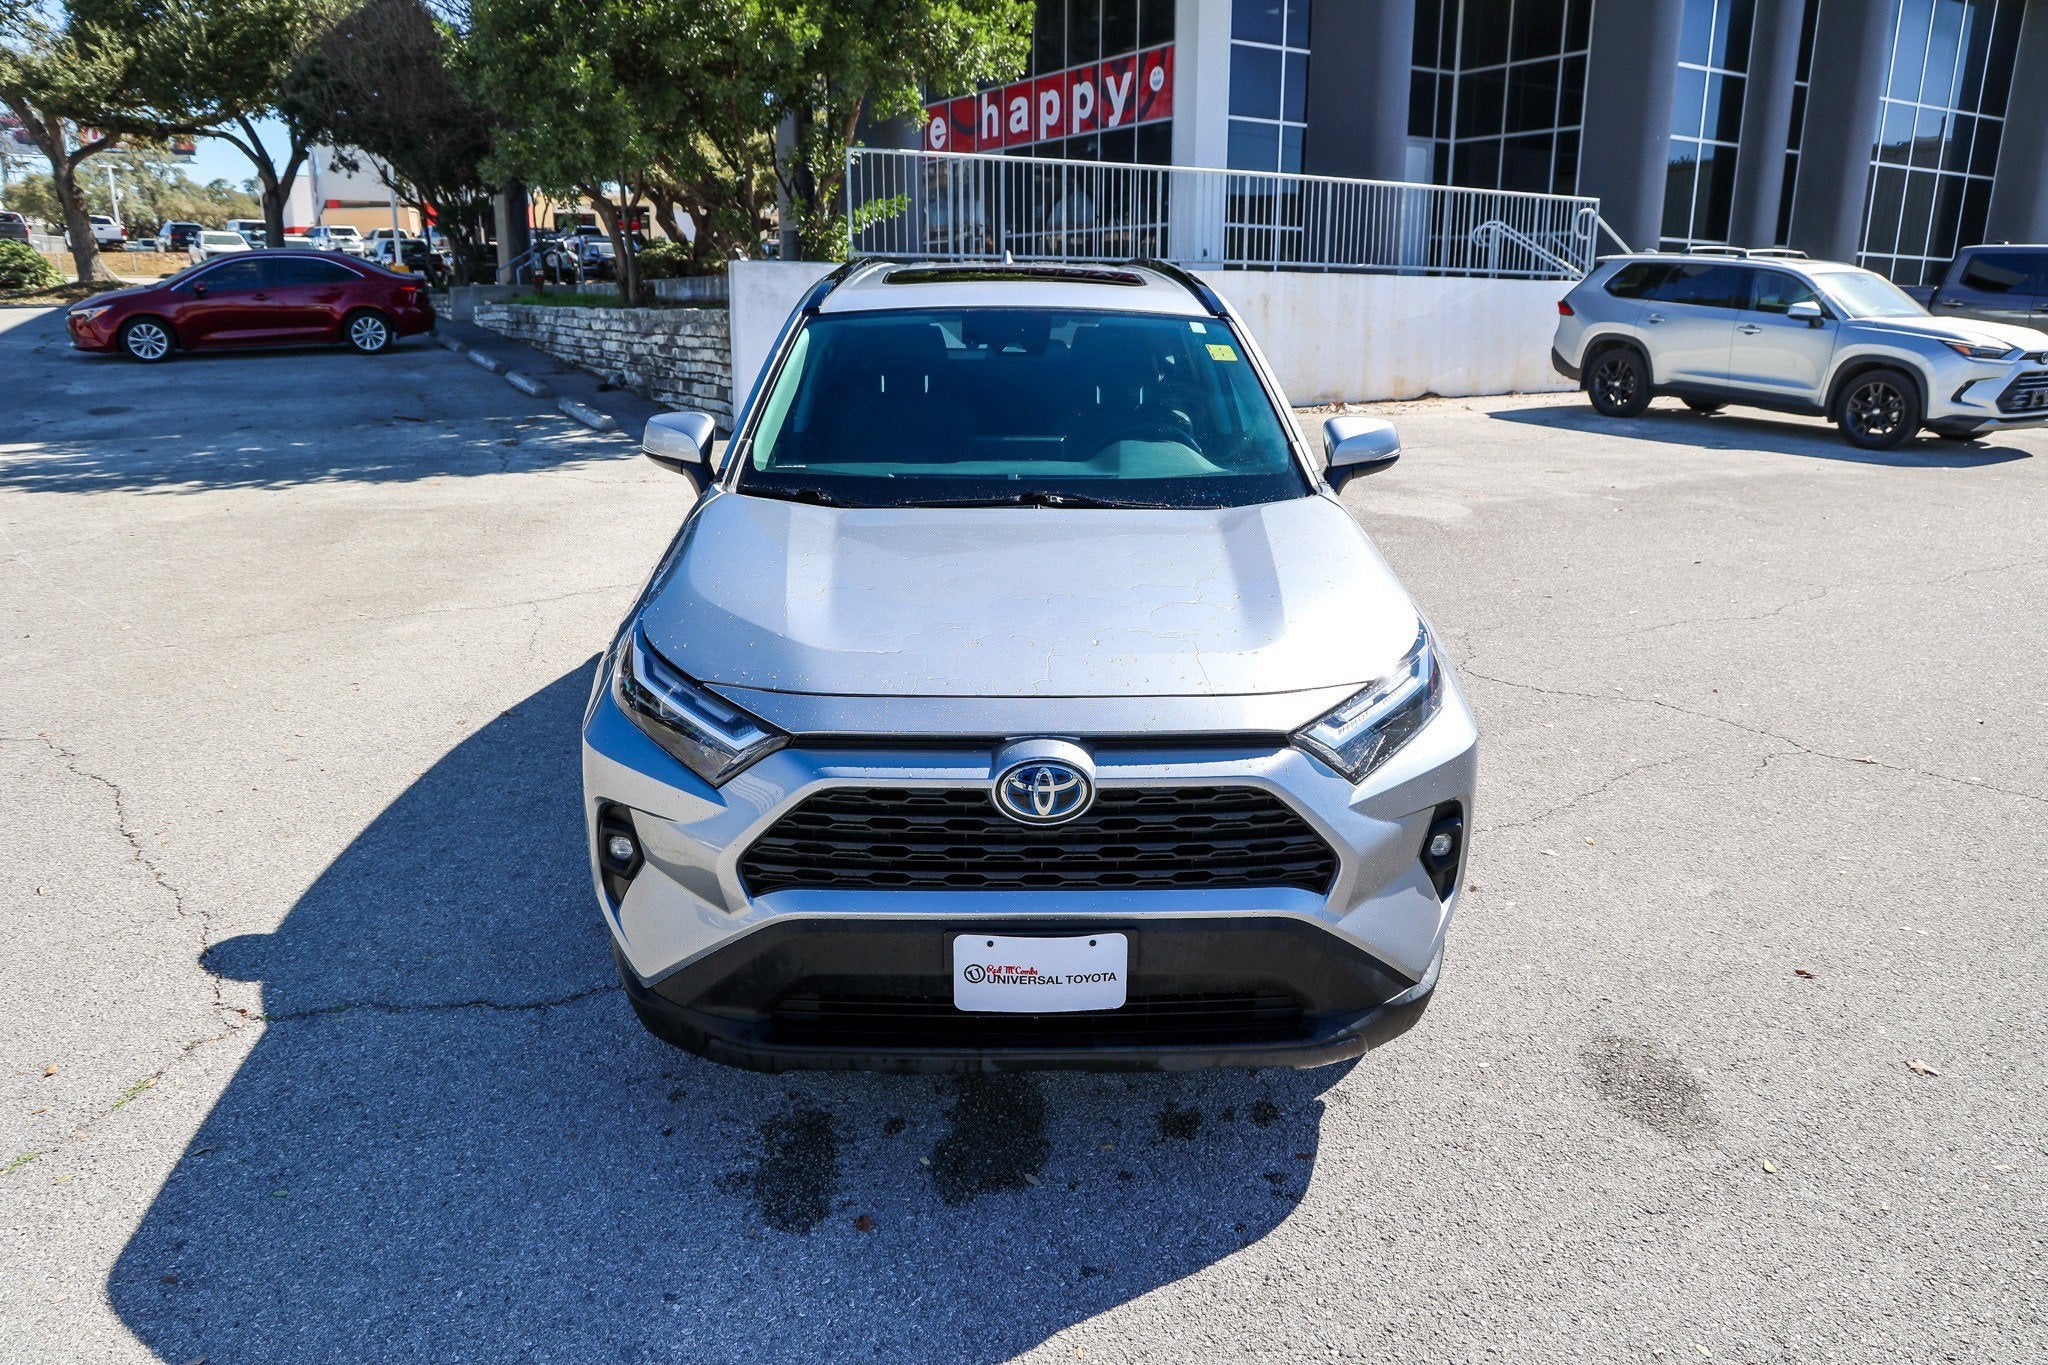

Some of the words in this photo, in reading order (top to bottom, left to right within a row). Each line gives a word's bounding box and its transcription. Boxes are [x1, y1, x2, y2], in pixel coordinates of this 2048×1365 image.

[981, 71, 1133, 140] happy
[987, 975, 1063, 985] UNIVERSAL
[1066, 972, 1117, 984] TOYOTA
